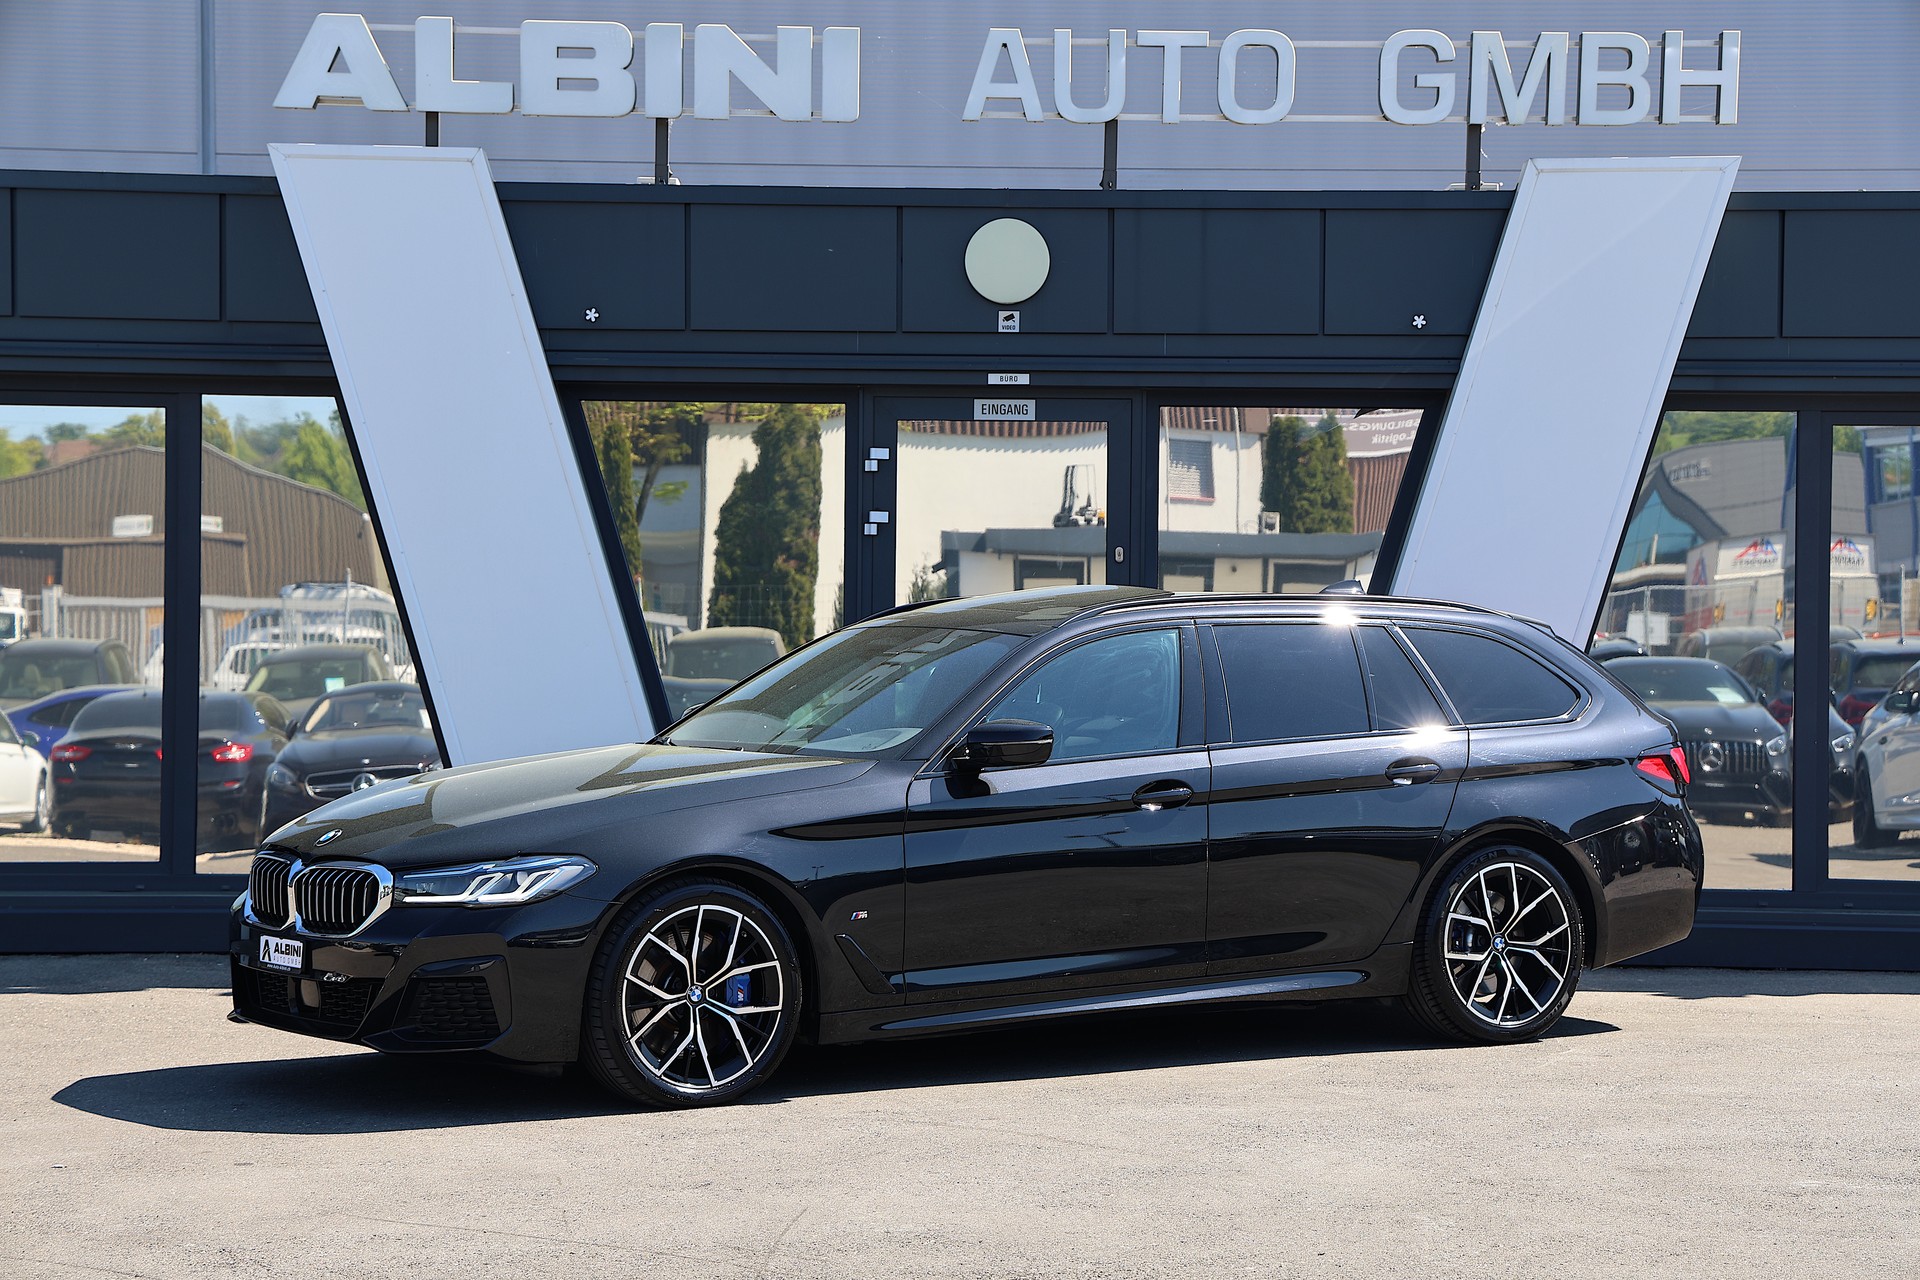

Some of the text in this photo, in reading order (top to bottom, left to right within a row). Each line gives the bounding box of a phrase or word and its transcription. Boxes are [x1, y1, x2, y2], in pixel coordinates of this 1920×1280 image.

[273, 13, 1742, 127] ALBINI AUTO GMBH
[999, 374, 1018, 382] BÜRO
[981, 403, 1029, 416] EINGANG
[1455, 850, 1498, 883] NEXEN
[274, 942, 301, 957] ALBINI
